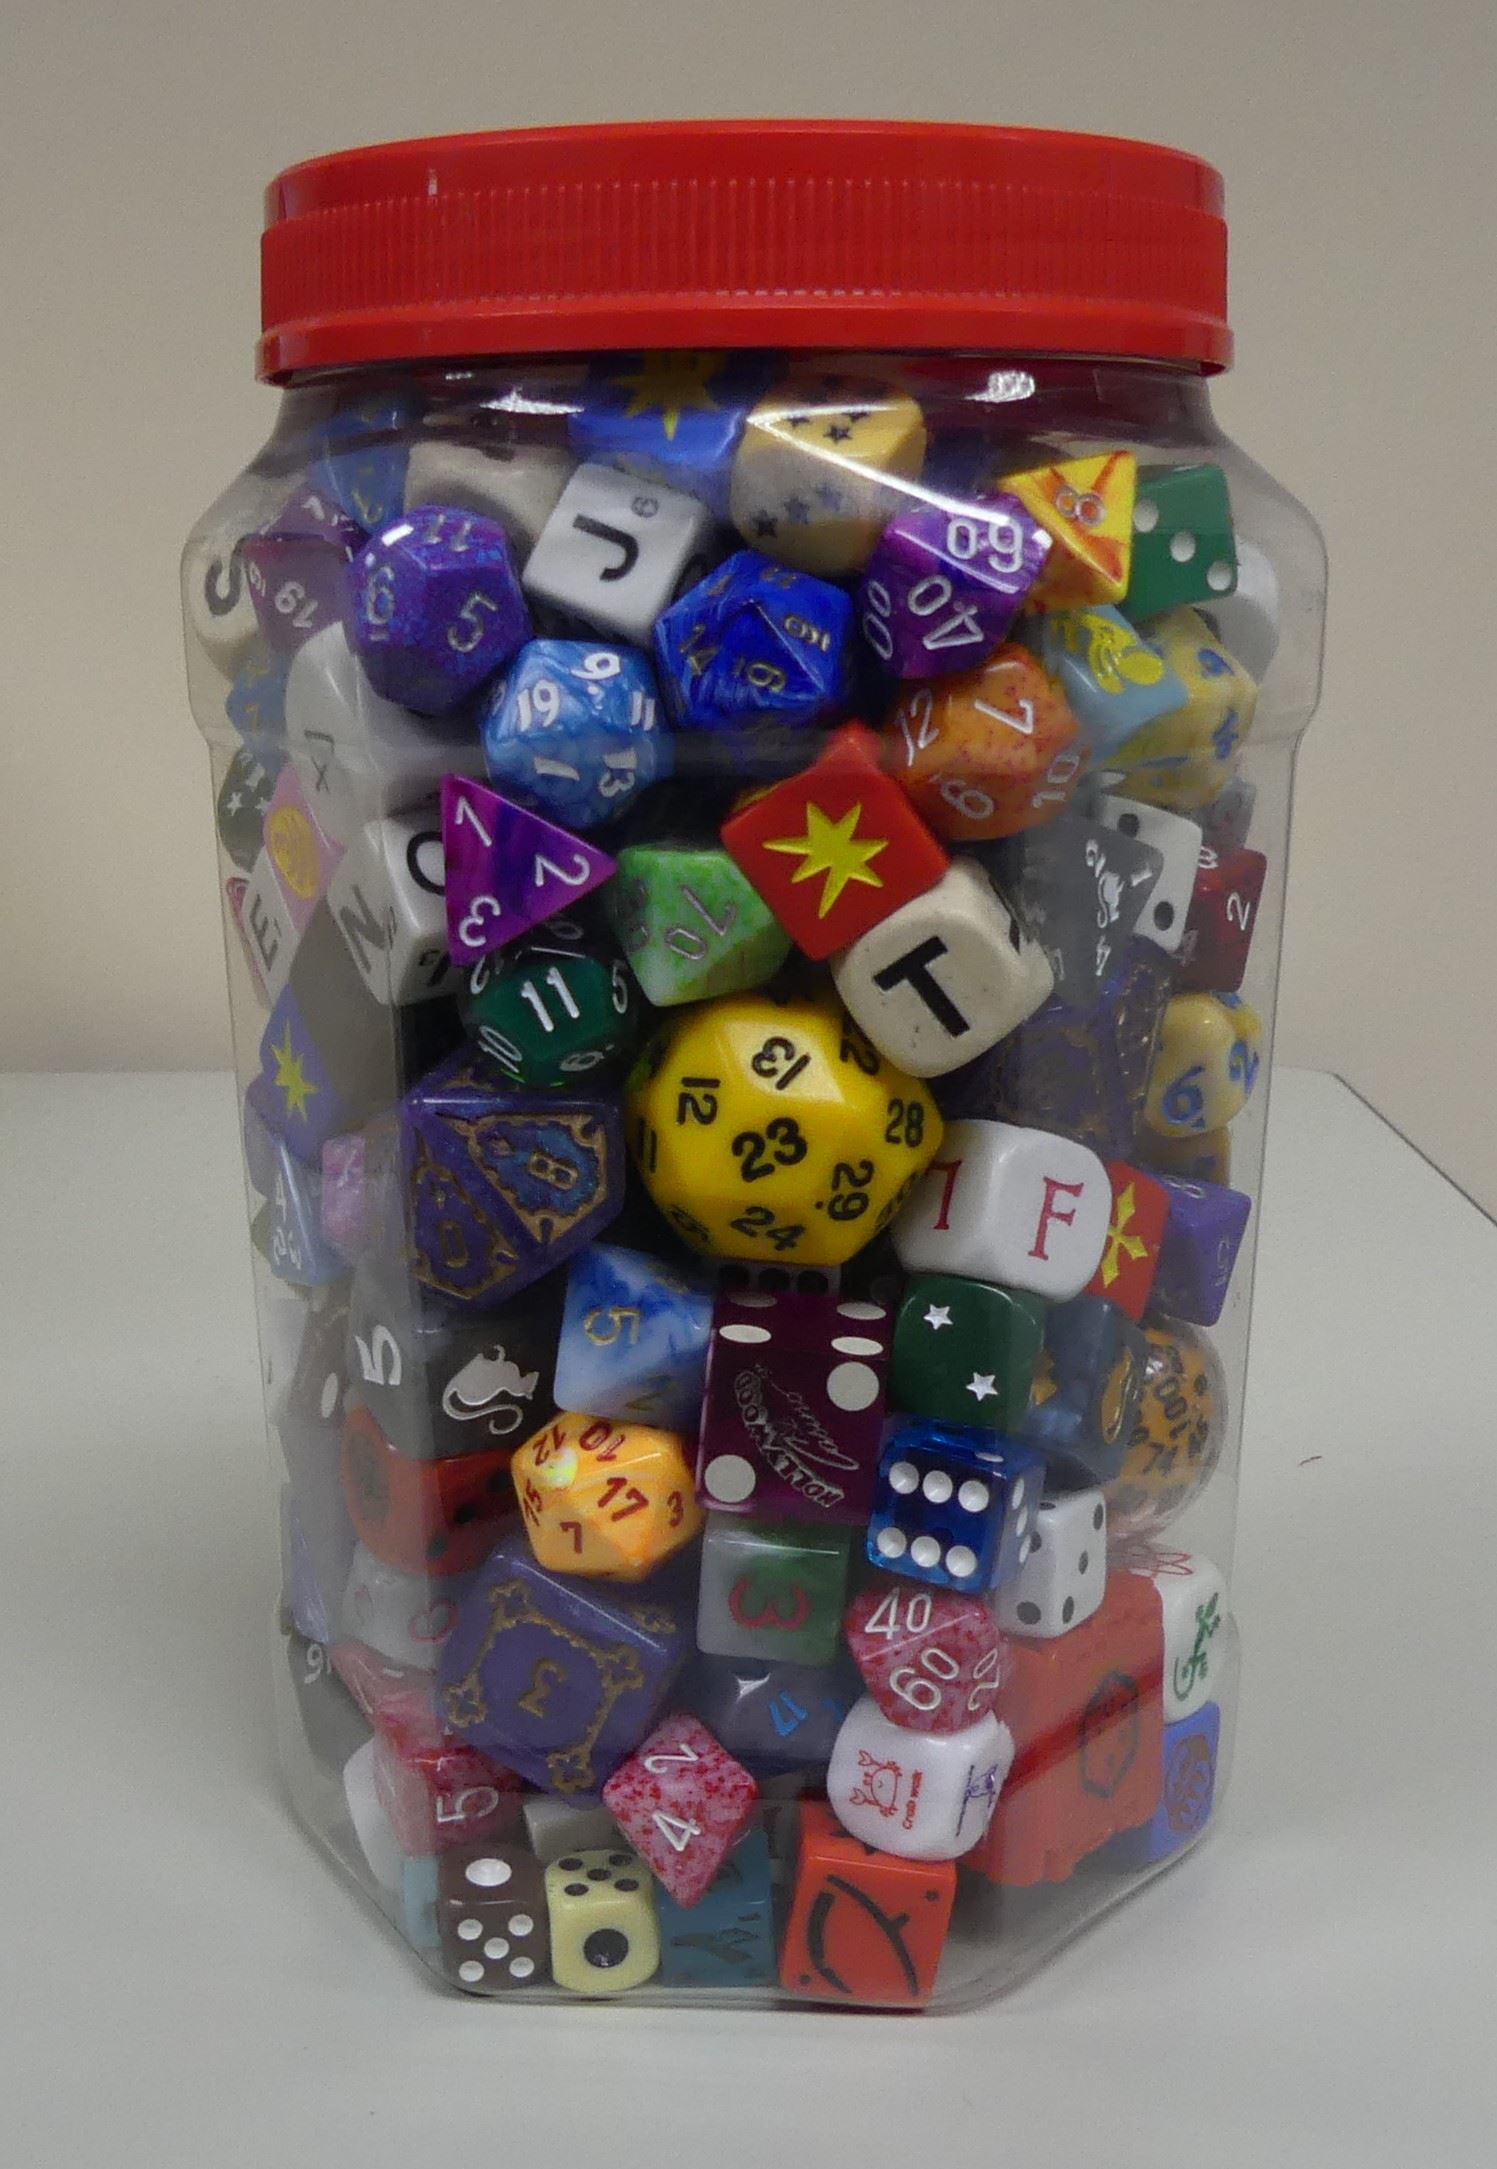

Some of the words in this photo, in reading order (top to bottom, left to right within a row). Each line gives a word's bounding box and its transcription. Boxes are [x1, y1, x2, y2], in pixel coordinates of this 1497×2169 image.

[572, 514, 640, 583] J
[447, 590, 498, 653] 5
[907, 574, 985, 651] 40
[516, 678, 561, 732] 19
[899, 689, 939, 768] 12
[454, 795, 493, 848] 1
[534, 853, 591, 888] 2
[458, 895, 501, 948] 3
[1226, 892, 1250, 931] 2
[520, 966, 581, 1032] 11
[872, 934, 971, 1039] T
[477, 1025, 524, 1075] 10
[750, 1035, 812, 1091] 13
[675, 1075, 722, 1126] 12
[885, 1098, 924, 1149] 28
[731, 1116, 808, 1183] 23
[730, 1205, 806, 1251] 24
[1027, 1174, 1085, 1262] F
[583, 1304, 642, 1346] 5
[354, 1323, 402, 1387] 5
[532, 1424, 567, 1467] 12
[579, 1420, 627, 1463] 10
[597, 1475, 650, 1523] 17
[666, 1490, 684, 1528] 3
[559, 1520, 584, 1555] 7
[728, 1574, 814, 1632] 3
[864, 1586, 933, 1640] 40
[888, 1648, 961, 1712] 60
[966, 1647, 1000, 1712] 20
[645, 1743, 700, 1774] 2
[436, 1785, 500, 1824] 5
[652, 1808, 702, 1852] 4
